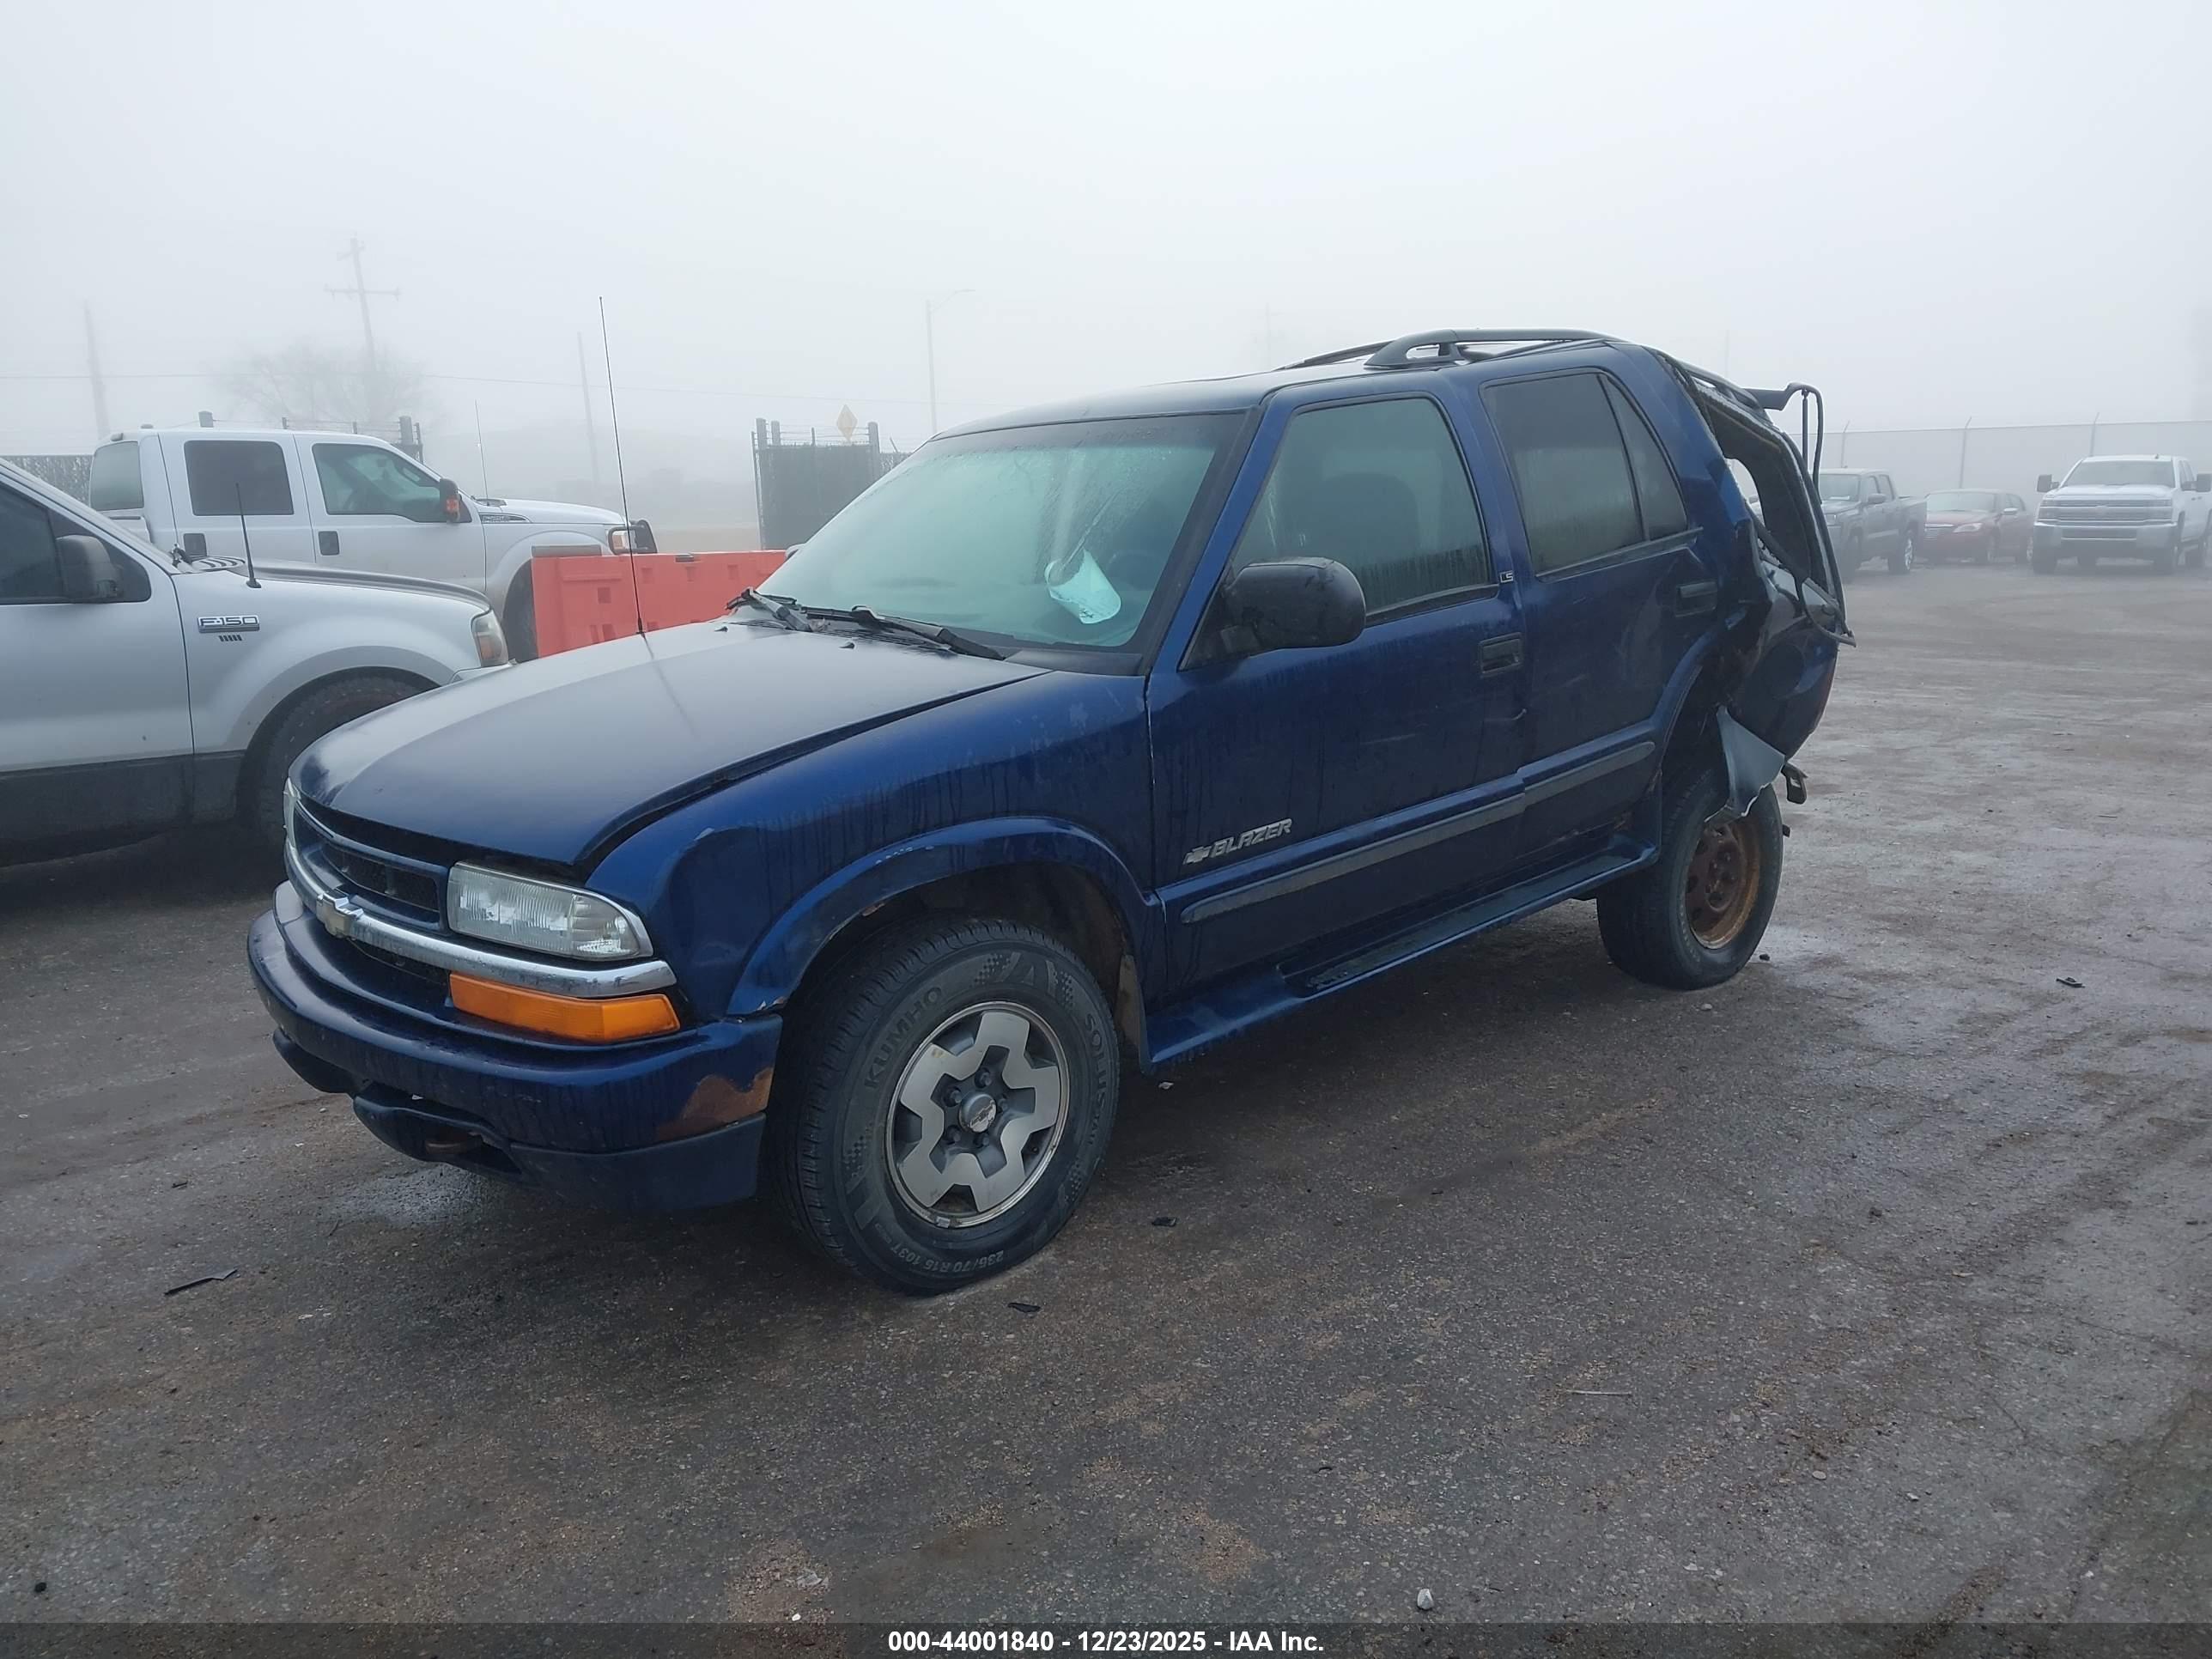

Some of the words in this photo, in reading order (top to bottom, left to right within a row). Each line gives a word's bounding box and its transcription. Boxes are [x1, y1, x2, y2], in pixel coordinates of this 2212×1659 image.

[198, 616, 258, 627] F-150
[1210, 817, 1292, 858] BLAZER
[864, 986, 943, 1089] KUMHO
[1085, 1012, 1108, 1109] SOLUS
[921, 1258, 952, 1273] R15
[952, 1249, 1004, 1273] 235/70
